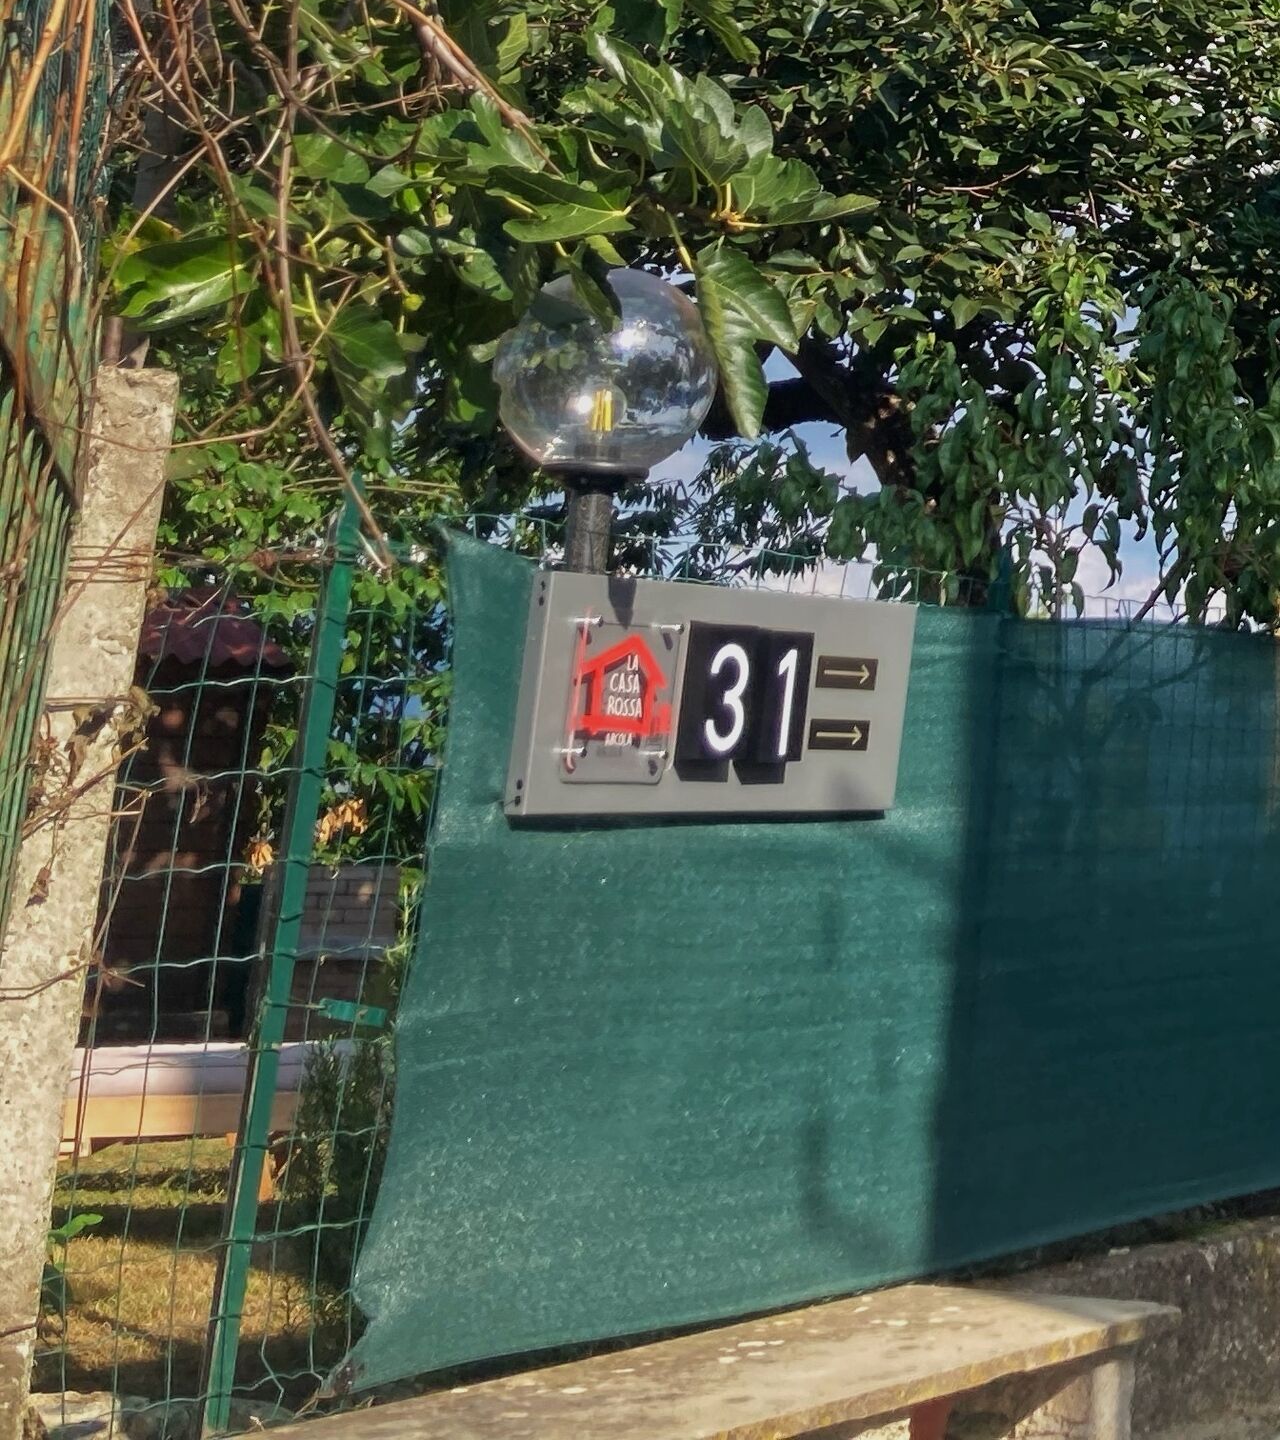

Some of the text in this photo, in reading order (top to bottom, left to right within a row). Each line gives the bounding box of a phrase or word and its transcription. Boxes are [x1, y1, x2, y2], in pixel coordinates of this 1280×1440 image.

[627, 655, 639, 671] LA
[610, 673, 640, 694] CASA
[607, 697, 642, 719] ROSSA
[705, 643, 798, 757] 31
